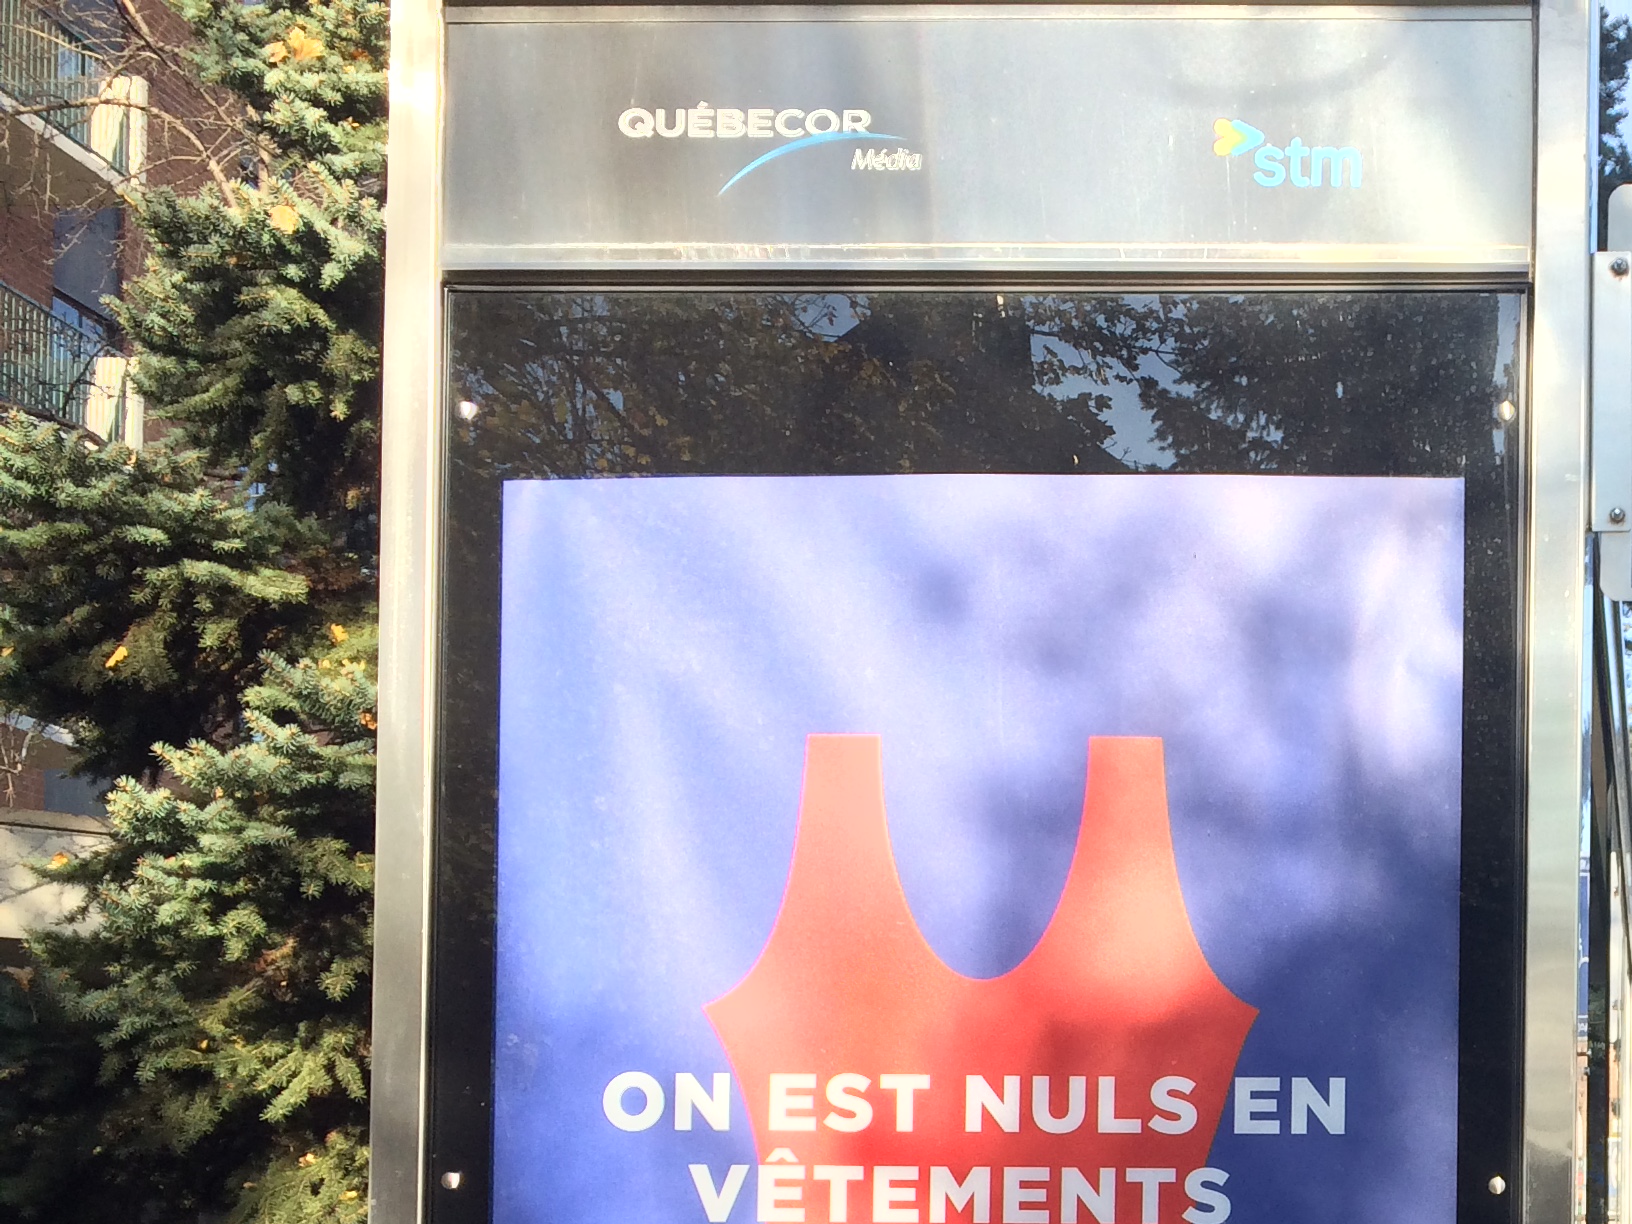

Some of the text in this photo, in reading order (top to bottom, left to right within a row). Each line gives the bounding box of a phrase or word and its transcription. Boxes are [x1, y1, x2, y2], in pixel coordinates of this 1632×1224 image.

[617, 101, 872, 140] QUÉBECOR
[850, 146, 922, 173] Média
[1253, 142, 1363, 189] stm
[602, 1071, 1346, 1135] ON EST NULS EN
